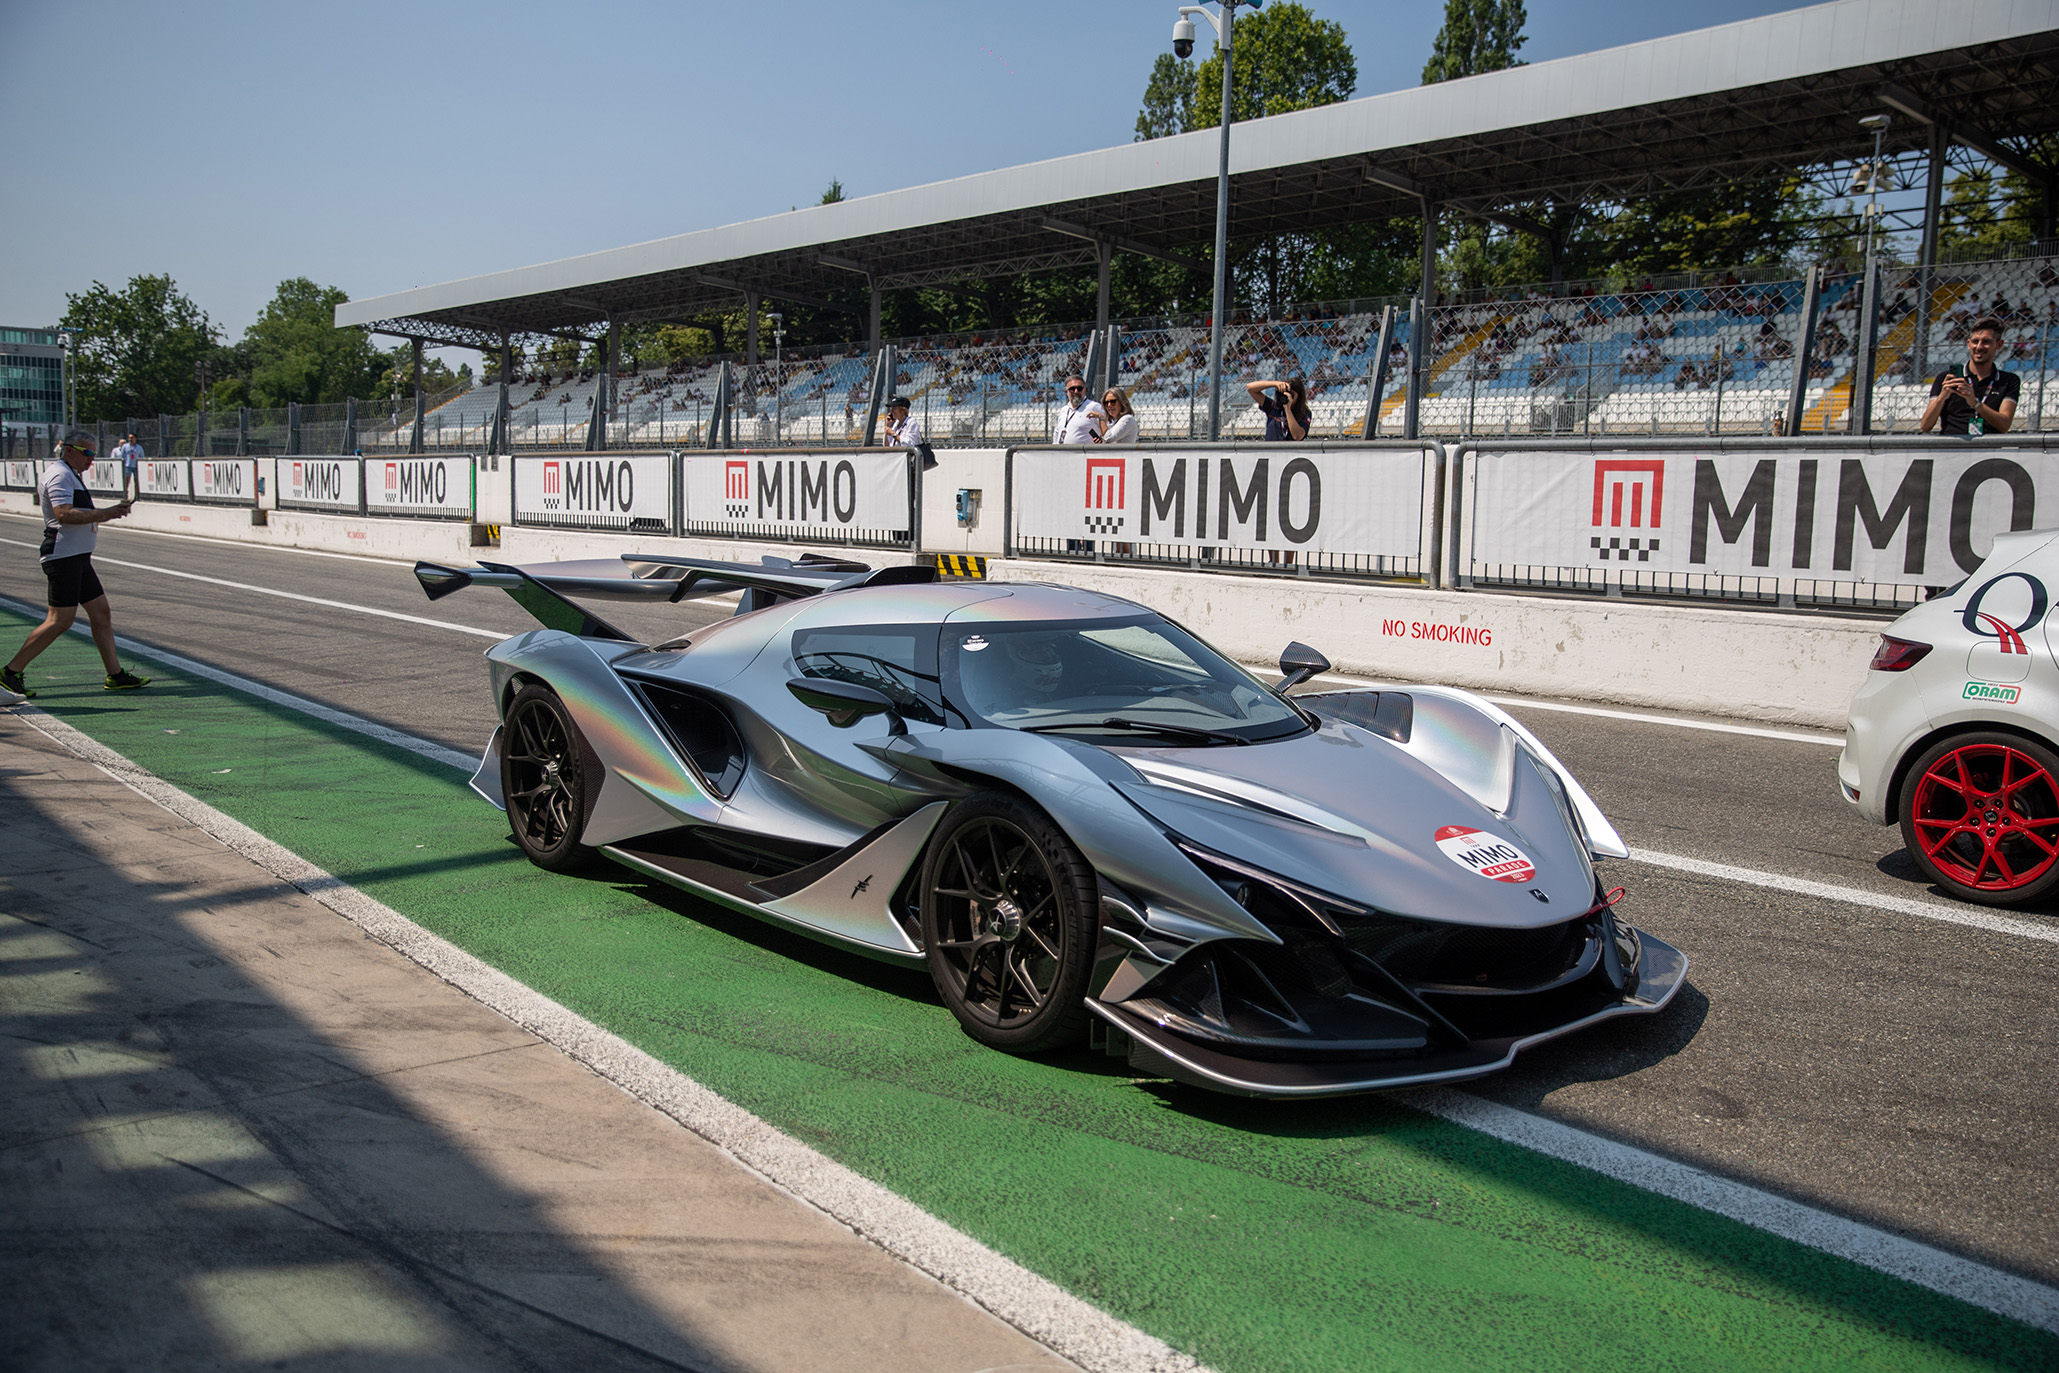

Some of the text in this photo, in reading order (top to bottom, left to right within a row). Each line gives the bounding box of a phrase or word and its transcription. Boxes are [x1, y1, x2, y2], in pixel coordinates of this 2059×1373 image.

[155, 463, 178, 491] MIMO
[213, 463, 241, 494] MIMO
[305, 462, 341, 500] MIMO
[400, 461, 446, 504] MIMO
[565, 460, 633, 512] MIMO
[757, 459, 856, 523] MIMO
[1140, 457, 1321, 543] MIMO
[1689, 458, 2035, 576] MIMO
[1382, 619, 1492, 646] NO SMOKING
[1967, 685, 2016, 701] ORAM
[1457, 844, 1518, 868] MIMO
[1487, 861, 1526, 875] PARADE
